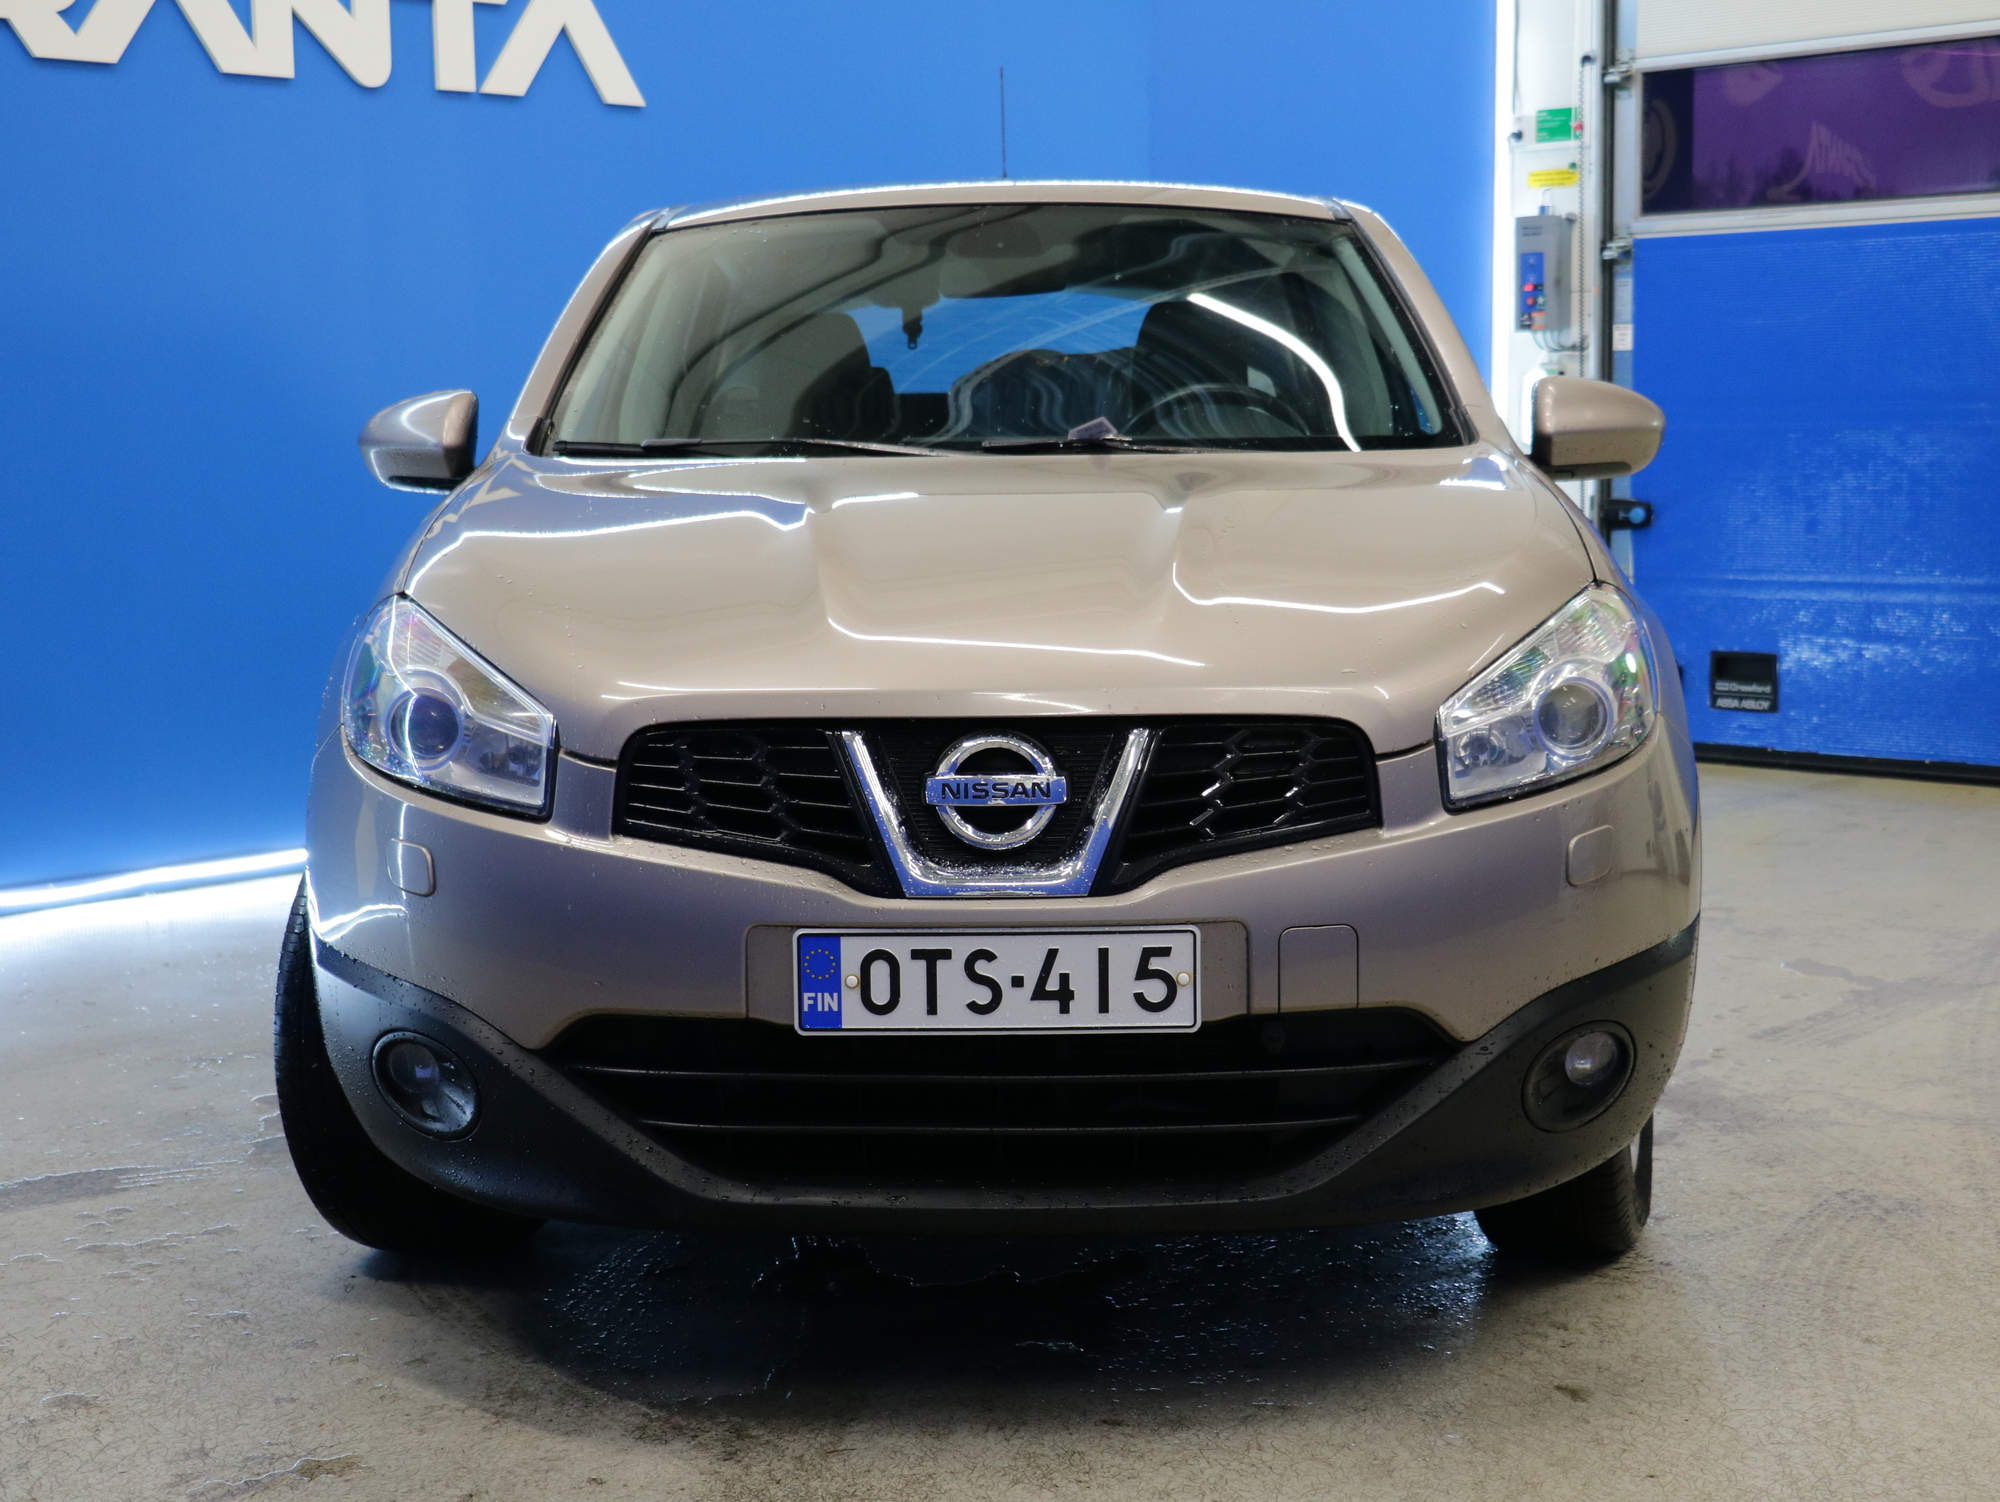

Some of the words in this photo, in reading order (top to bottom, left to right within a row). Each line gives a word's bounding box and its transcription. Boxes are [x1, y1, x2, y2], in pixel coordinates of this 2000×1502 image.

[1716, 697, 1739, 708] ASSA
[1740, 699, 1771, 710] ABLOY
[941, 782, 1051, 799] NISSAN
[803, 992, 839, 1012] FIN
